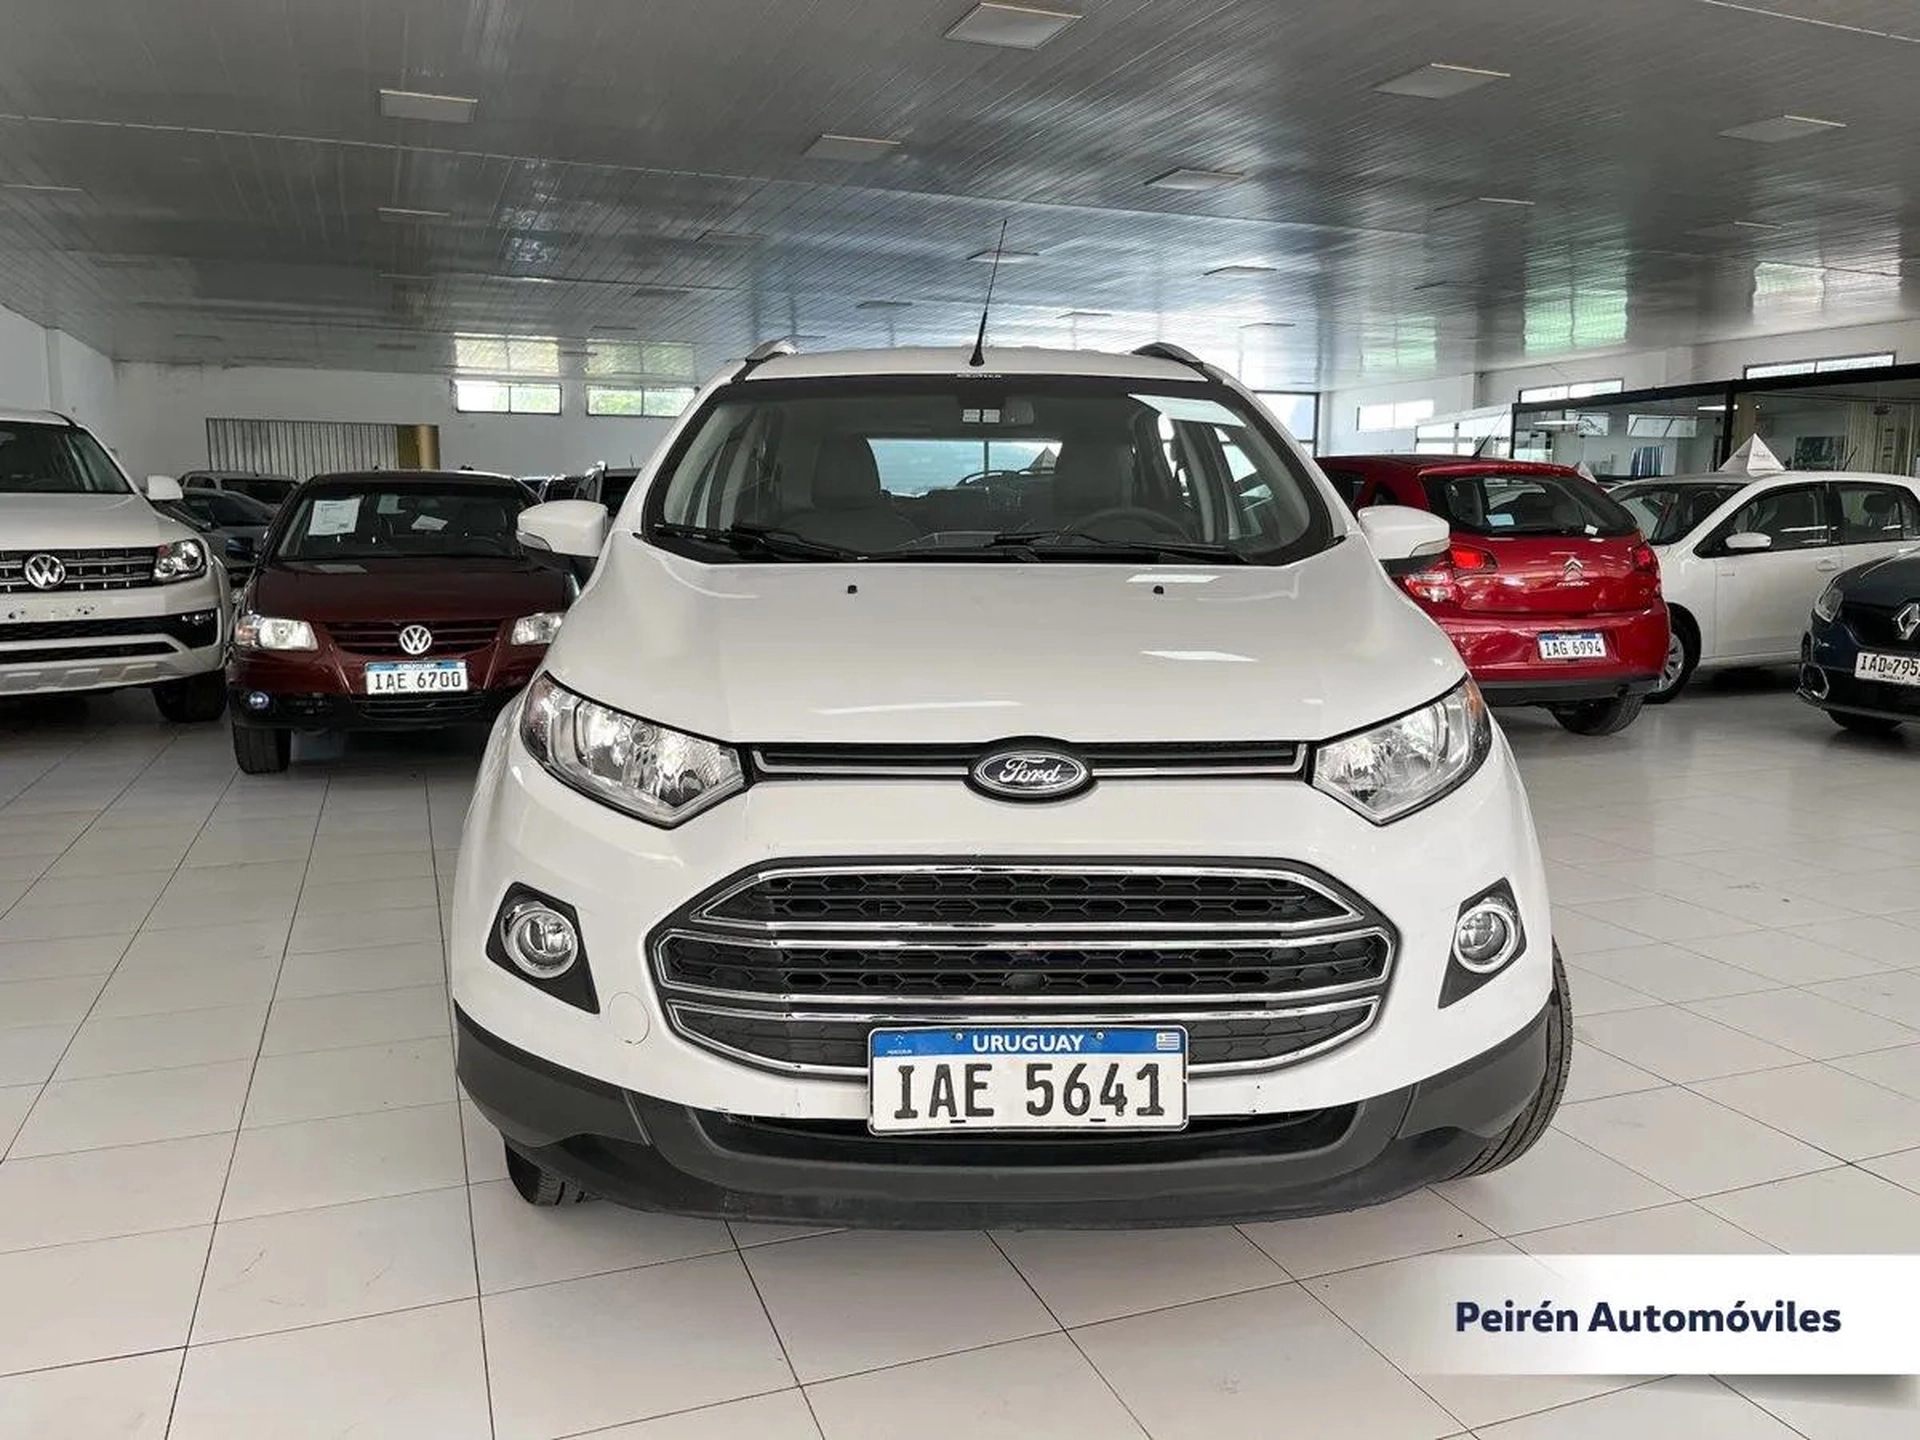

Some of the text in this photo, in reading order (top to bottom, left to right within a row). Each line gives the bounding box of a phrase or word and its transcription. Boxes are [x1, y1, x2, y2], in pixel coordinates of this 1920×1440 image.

[1545, 641, 1568, 656] IAG
[1892, 659, 1920, 677] 795
[375, 671, 461, 690] IAE 6700
[1000, 756, 1062, 783] Ford
[972, 1033, 1085, 1052] URUGUAY
[894, 1063, 1165, 1119] IAE 5641
